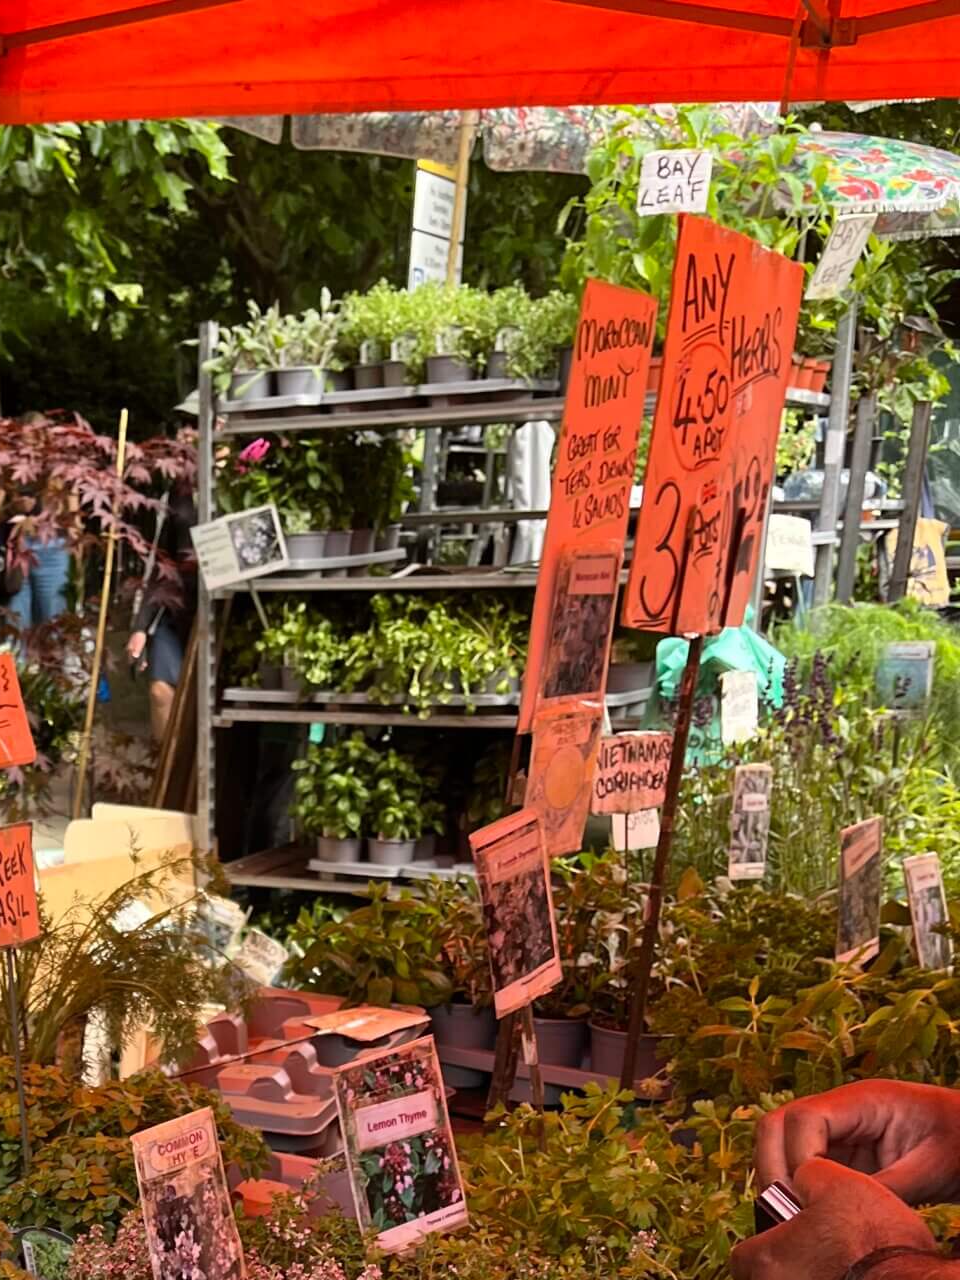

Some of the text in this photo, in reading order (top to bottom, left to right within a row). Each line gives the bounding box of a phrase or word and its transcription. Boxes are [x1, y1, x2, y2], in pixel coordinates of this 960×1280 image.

[657, 153, 702, 186] BAY
[640, 180, 705, 207] LEAF
[681, 253, 736, 346] ANY
[730, 306, 782, 384] HERBS
[584, 363, 635, 408] MINT
[693, 426, 725, 460] A POT
[639, 480, 682, 620] 3
[367, 1109, 428, 1133] Lemon Thyme
